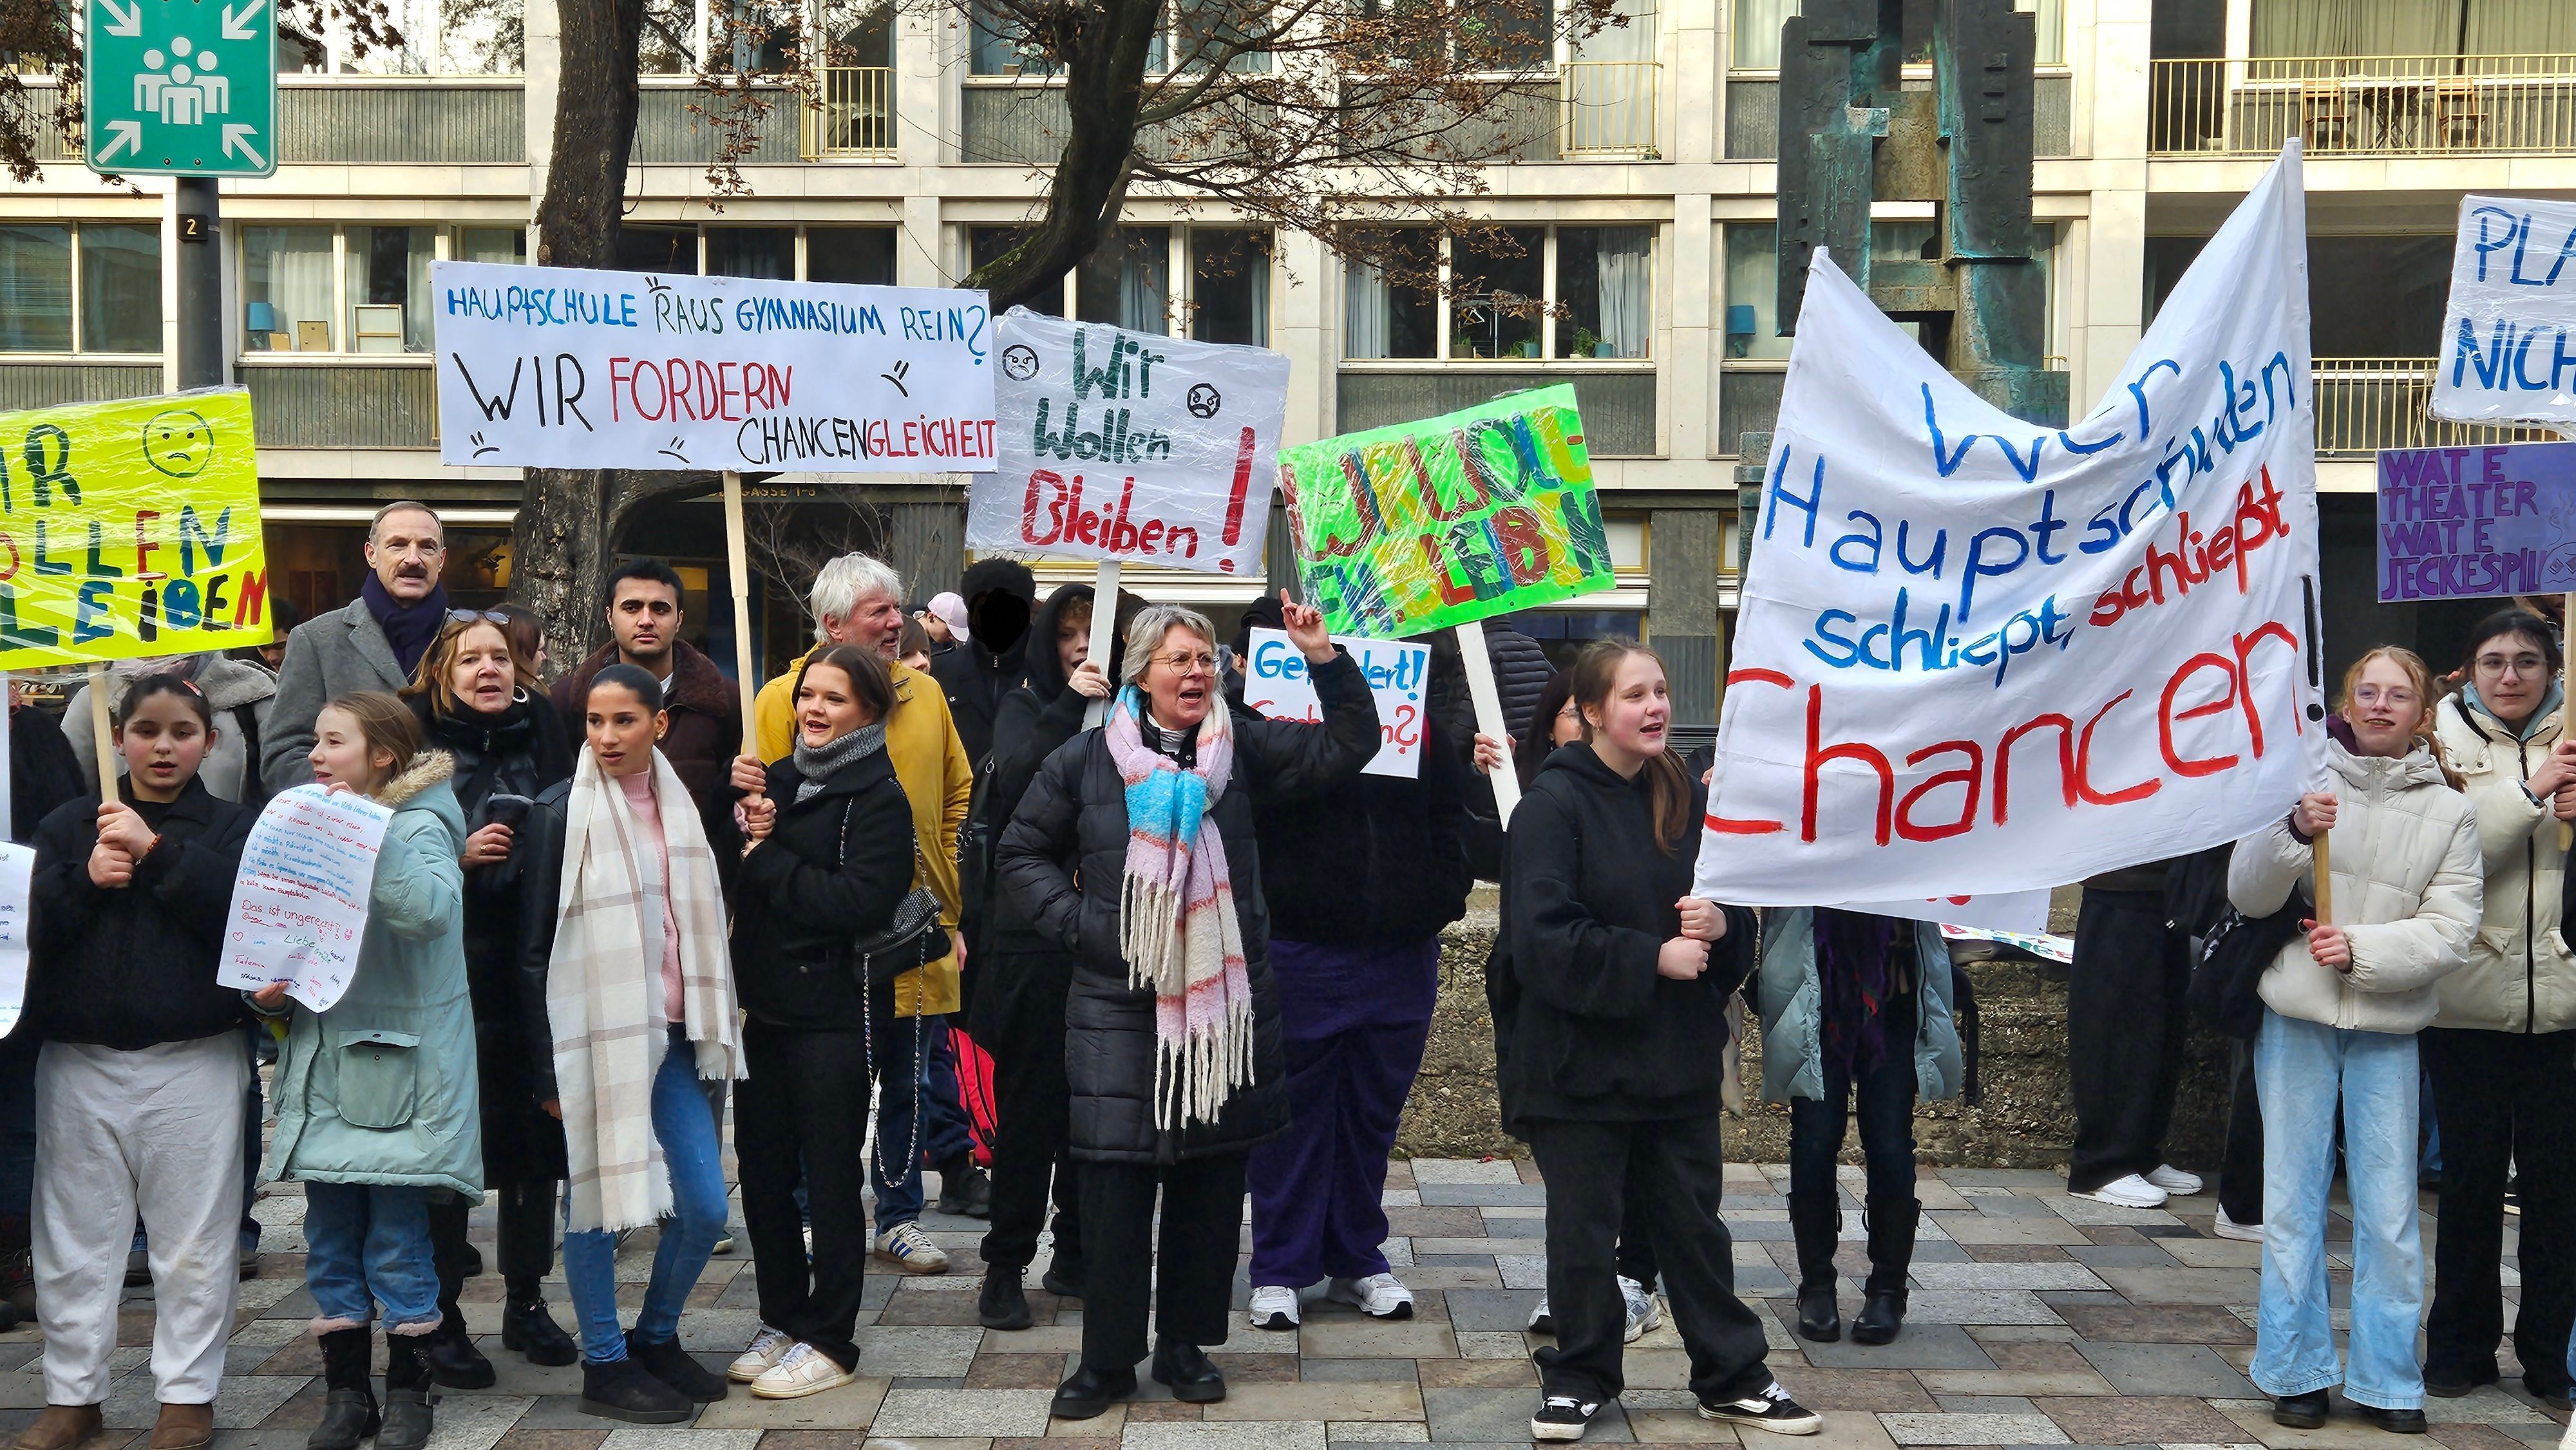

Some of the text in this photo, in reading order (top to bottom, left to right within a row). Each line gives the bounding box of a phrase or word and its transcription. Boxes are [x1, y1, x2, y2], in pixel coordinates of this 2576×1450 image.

[187, 218, 196, 235] 2
[655, 293, 723, 335] RAUS
[735, 296, 887, 337] GYMNASIUM
[900, 305, 987, 366] REIN?
[1072, 328, 1165, 400] Wir
[452, 352, 792, 433] WIR FORDERN
[1034, 397, 1171, 464] Wollen
[2382, 447, 2509, 487] WAT E
[2382, 481, 2539, 522] THEATER
[2381, 518, 2495, 557] WAT E
[242, 899, 263, 913] Das
[269, 905, 281, 916] ist
[283, 934, 316, 948] Liebe
